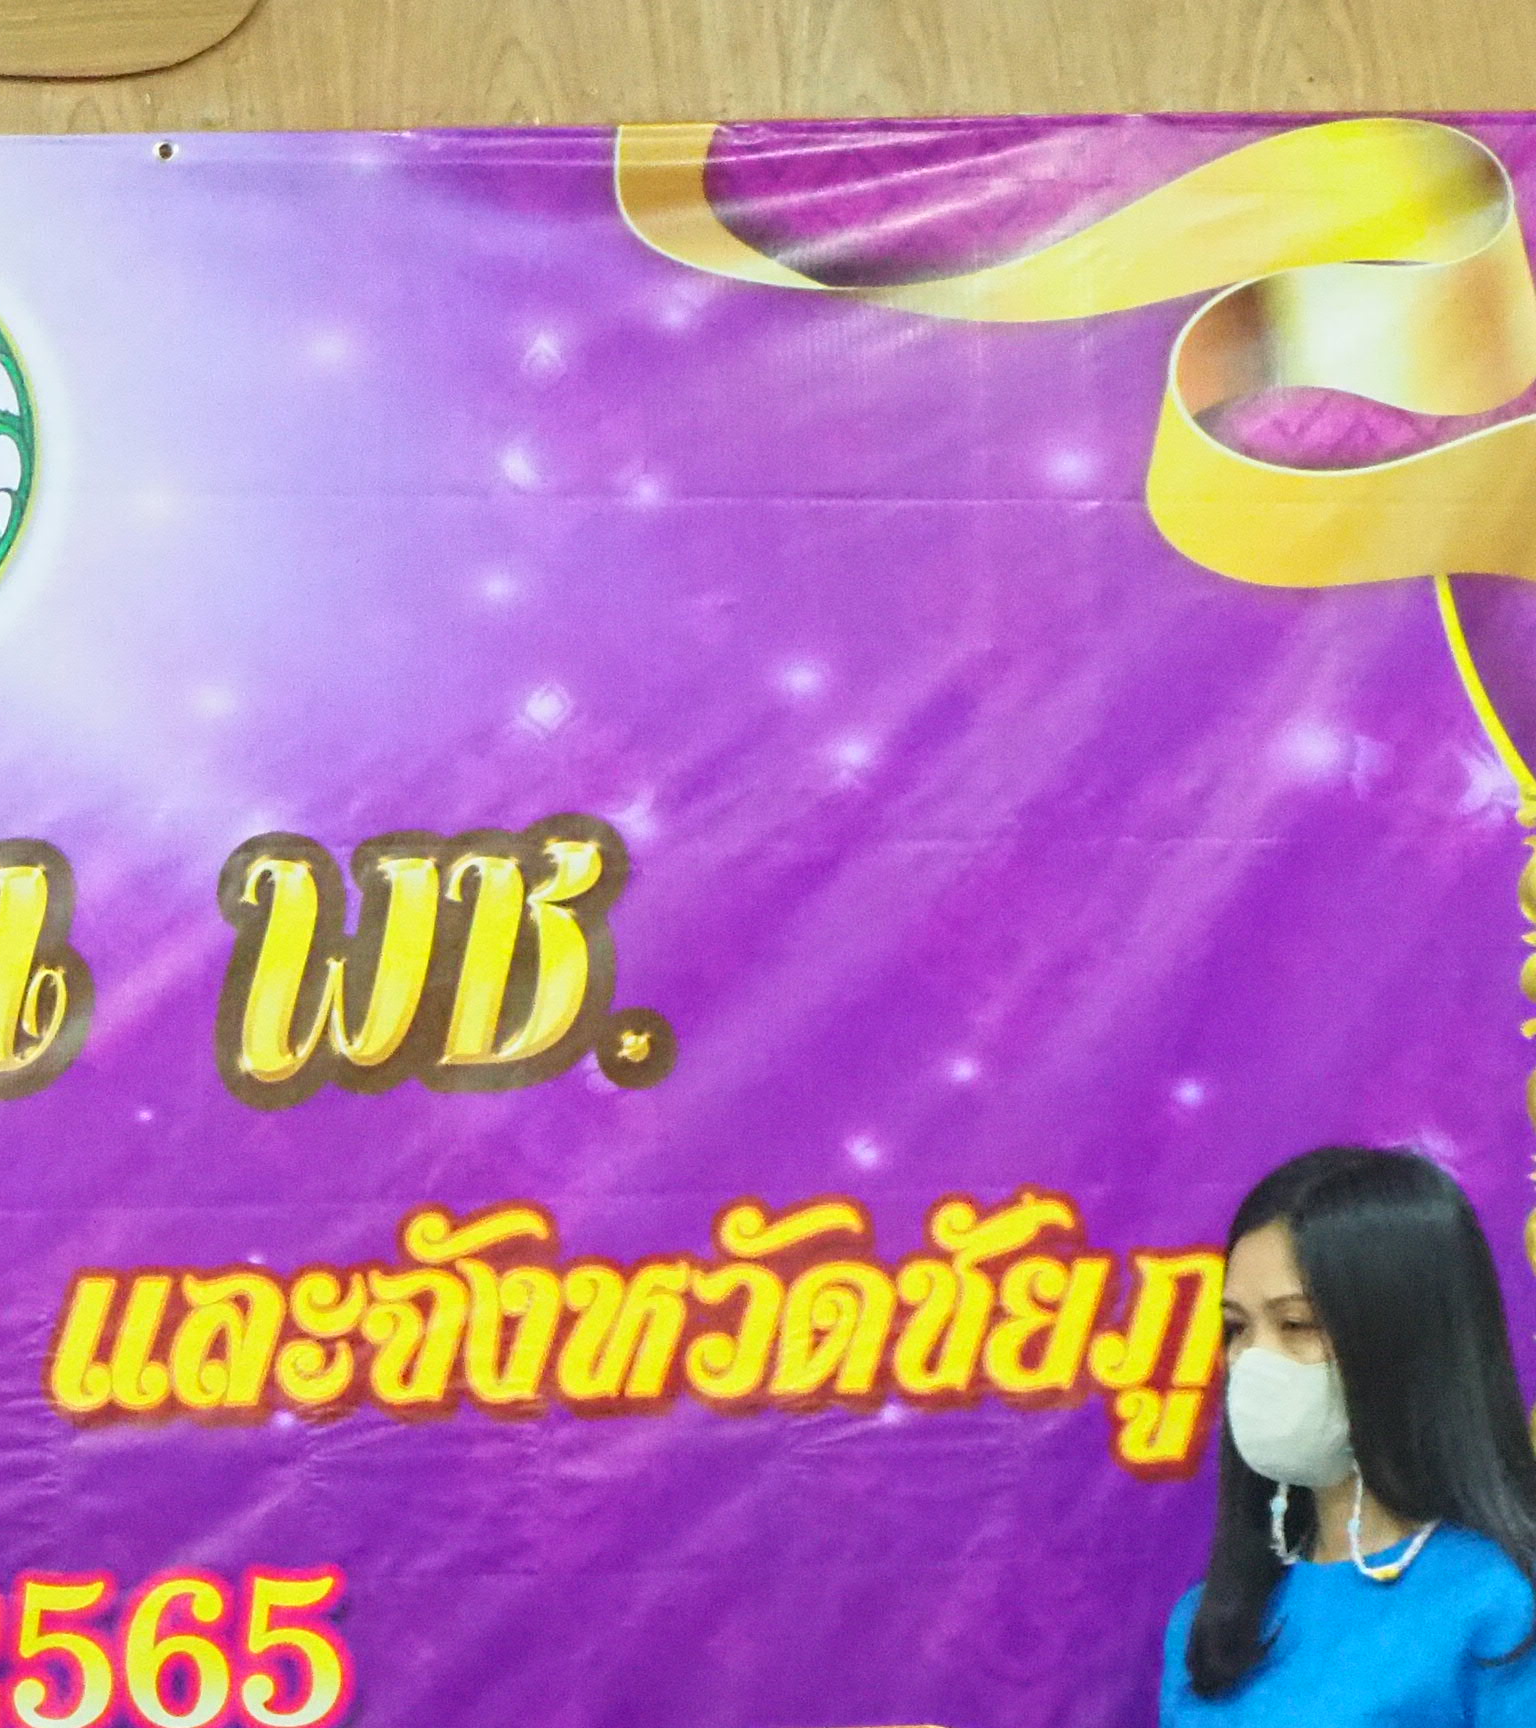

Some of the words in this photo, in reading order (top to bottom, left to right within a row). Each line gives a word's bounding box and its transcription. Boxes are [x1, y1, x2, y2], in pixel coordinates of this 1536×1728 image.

[236, 838, 652, 1081] พช.
[52, 1193, 1226, 1464] และจังหวัดชัยภู
